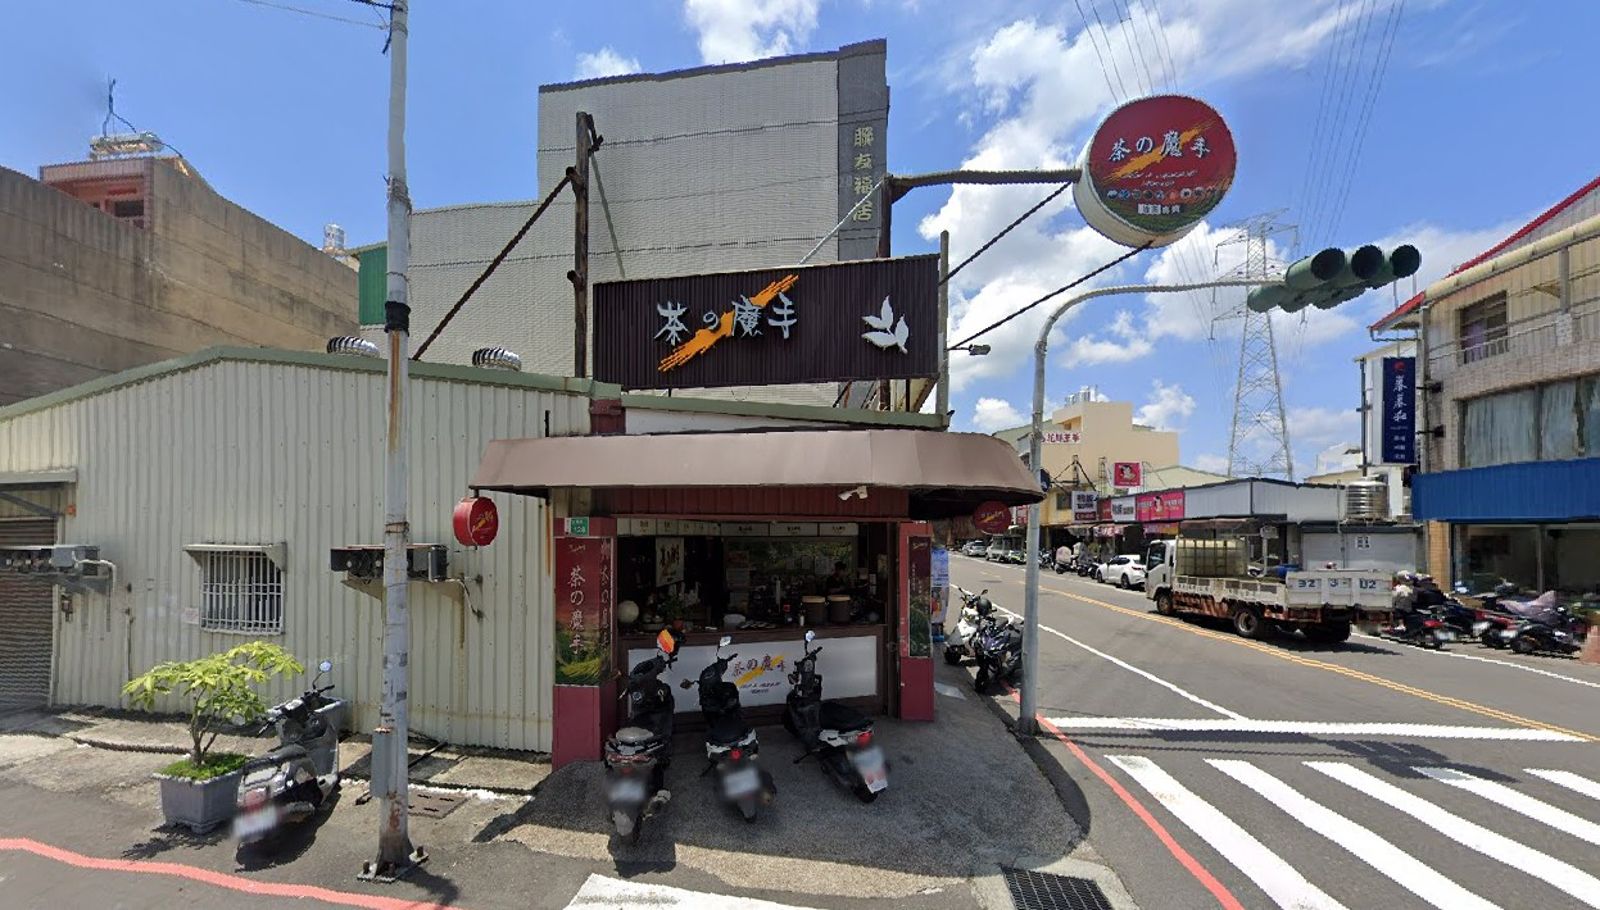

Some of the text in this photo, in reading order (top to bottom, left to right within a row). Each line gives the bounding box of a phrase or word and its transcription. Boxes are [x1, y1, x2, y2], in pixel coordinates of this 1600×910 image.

[1109, 131, 1210, 161] 茶の魔手
[654, 291, 798, 345] 茶の魔手
[568, 566, 586, 654] 茶の魔手
